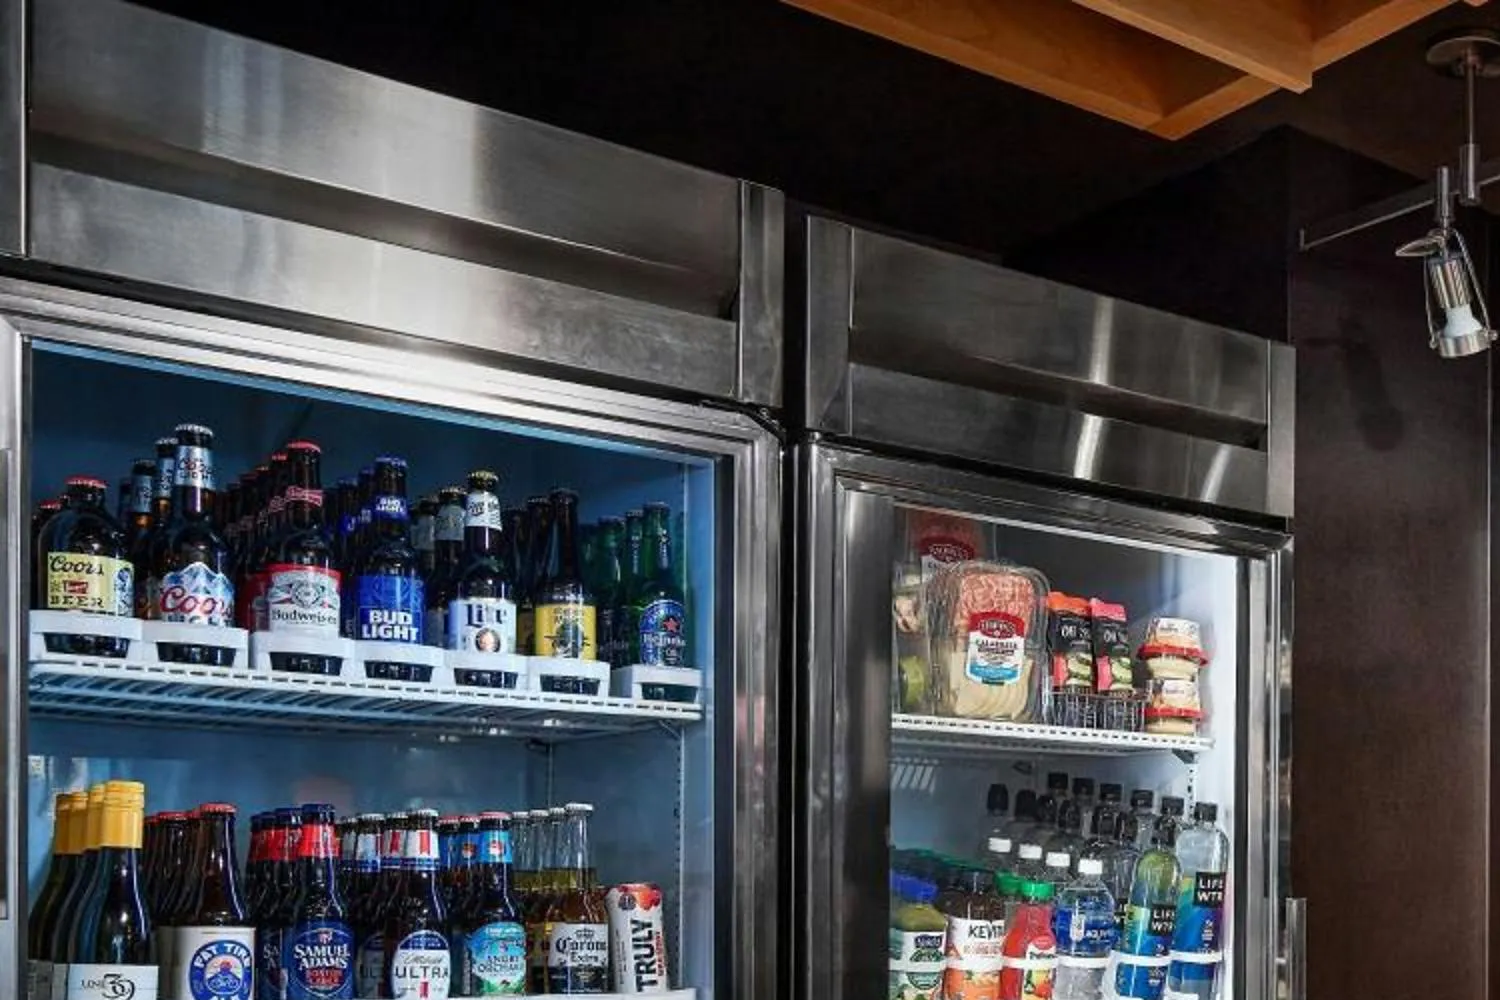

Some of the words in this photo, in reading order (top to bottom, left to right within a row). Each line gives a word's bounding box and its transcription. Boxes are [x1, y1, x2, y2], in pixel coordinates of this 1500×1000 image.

[271, 608, 338, 626] Budweiser
[369, 609, 412, 626] BUD
[361, 625, 419, 642] LIGHT
[293, 943, 349, 960] SAMUEL
[630, 917, 660, 993] TRULY
[299, 955, 348, 970] ADAMS
[395, 965, 449, 980] ULTRA
